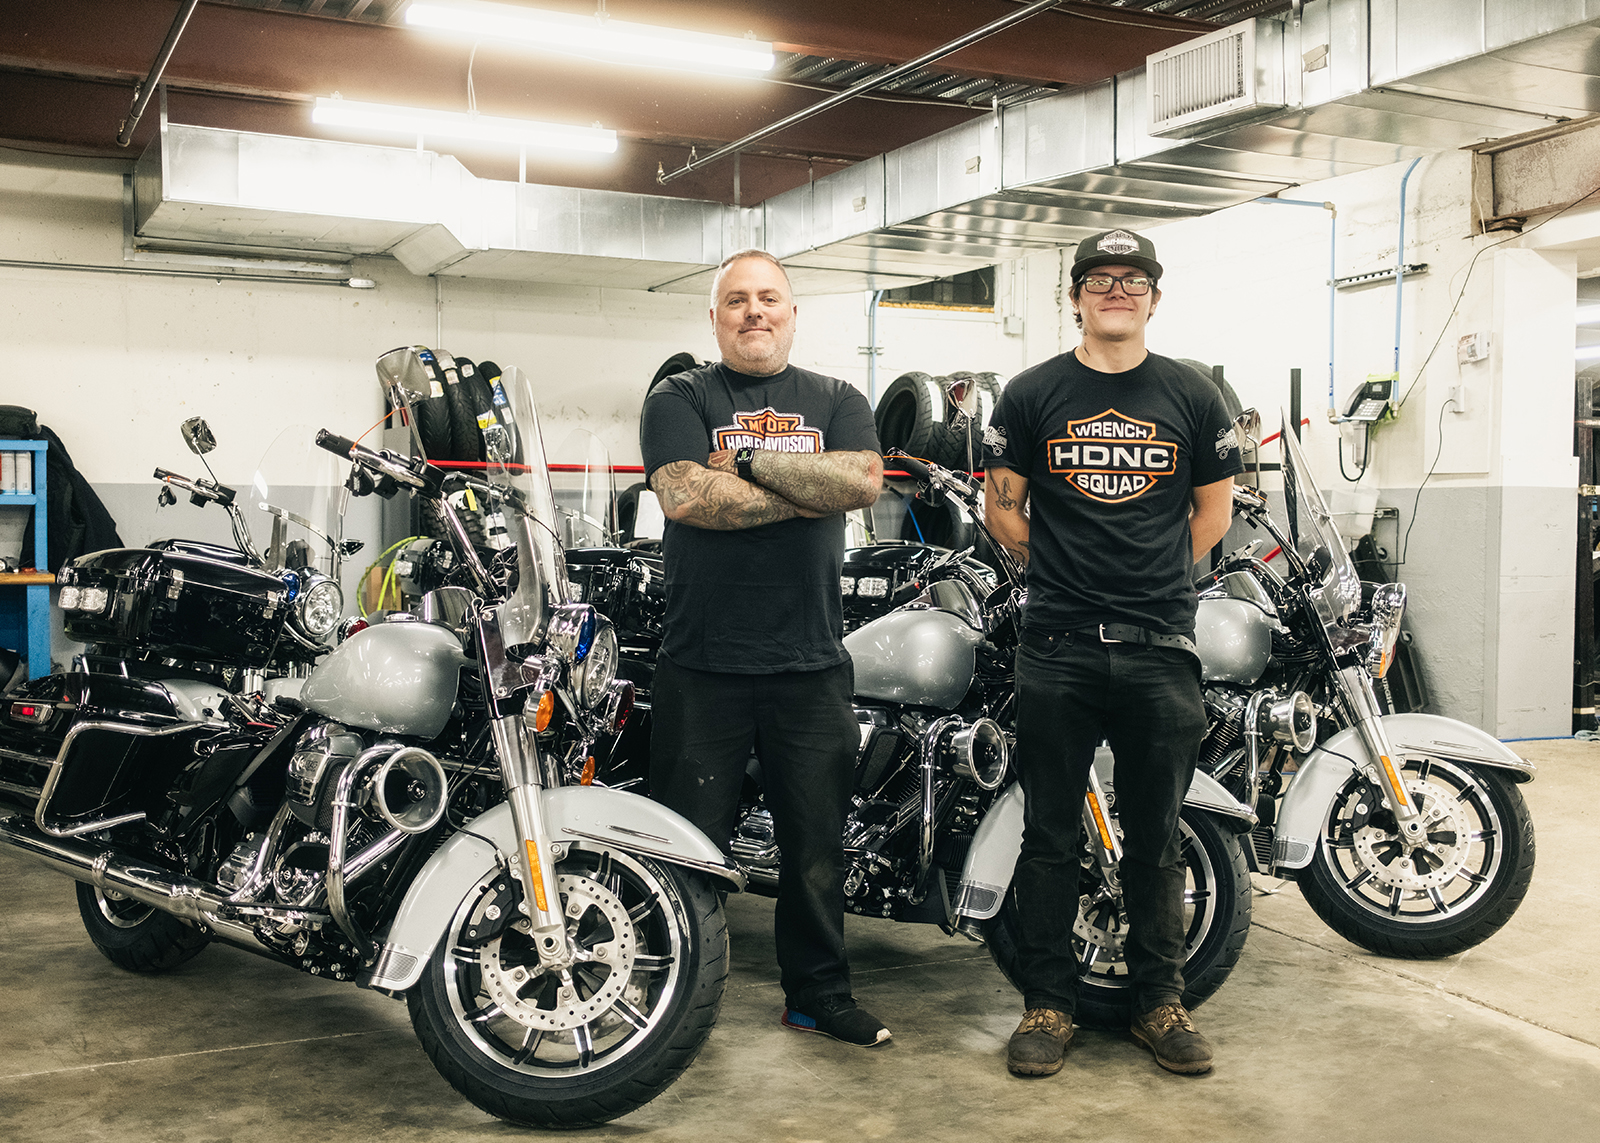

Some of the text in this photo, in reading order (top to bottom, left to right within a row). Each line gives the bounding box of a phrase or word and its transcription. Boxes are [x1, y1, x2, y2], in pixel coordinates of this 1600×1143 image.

[748, 417, 790, 432] MOOR
[1075, 421, 1148, 439] WRENCH
[1054, 445, 1170, 469] HDNC
[1077, 474, 1146, 496] SQUAD
